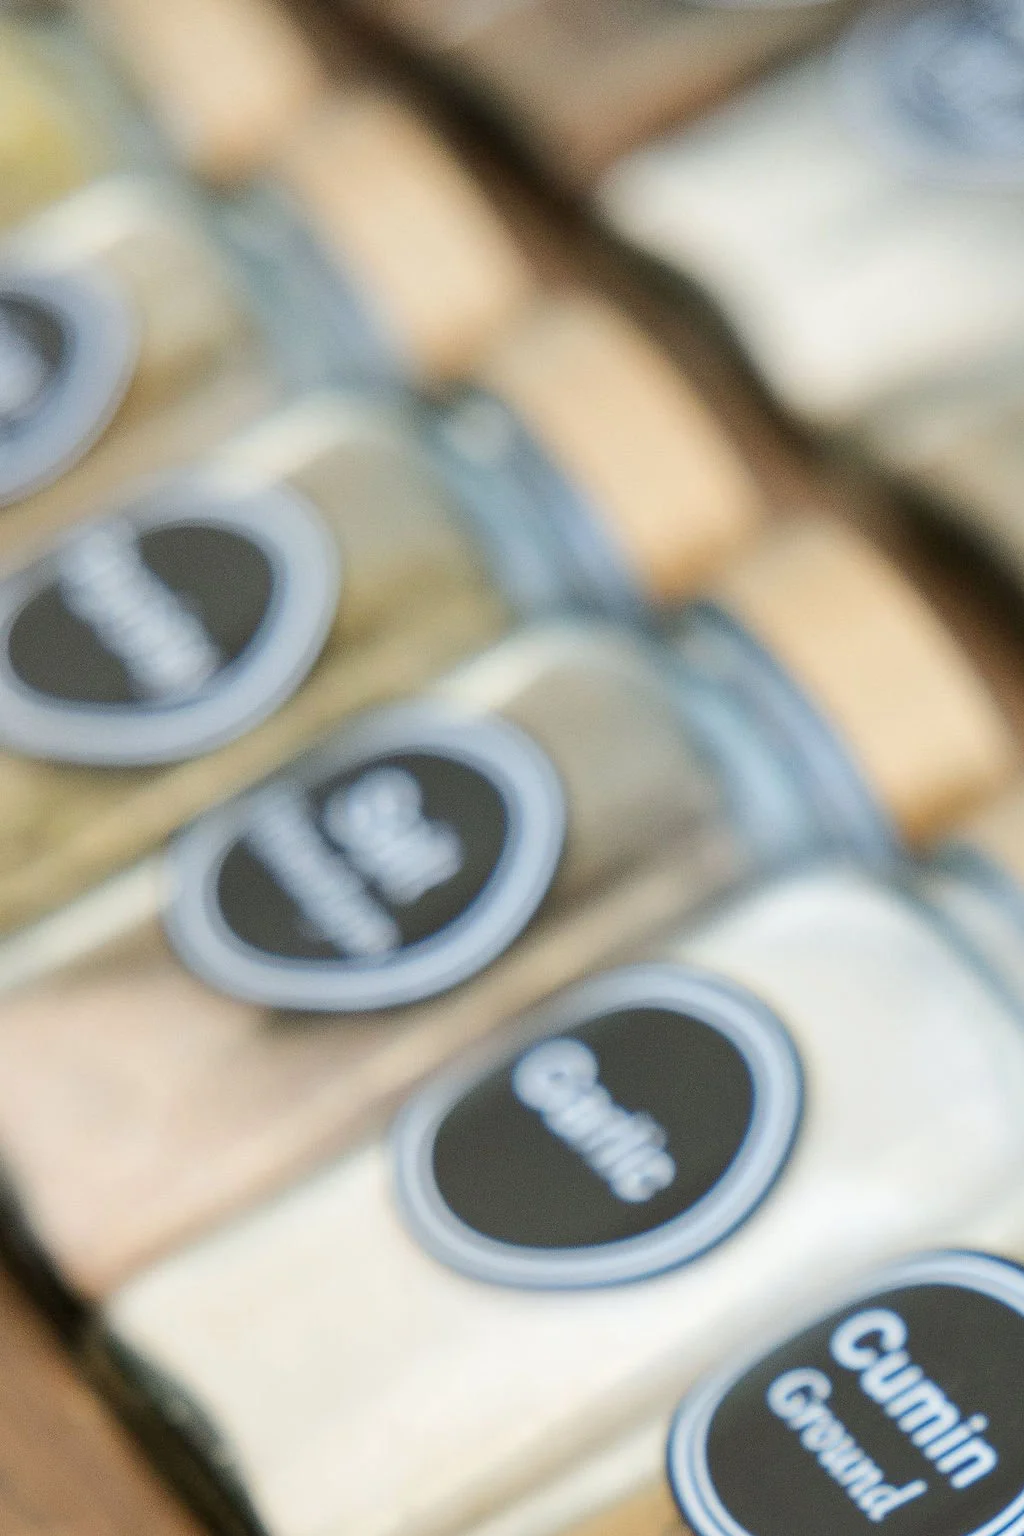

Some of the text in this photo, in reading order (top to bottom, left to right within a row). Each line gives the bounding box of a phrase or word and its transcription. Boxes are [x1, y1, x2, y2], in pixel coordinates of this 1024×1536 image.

[512, 1038, 677, 1204] Garlic
[766, 1367, 929, 1523] Ground
[828, 1308, 998, 1490] Cumin
